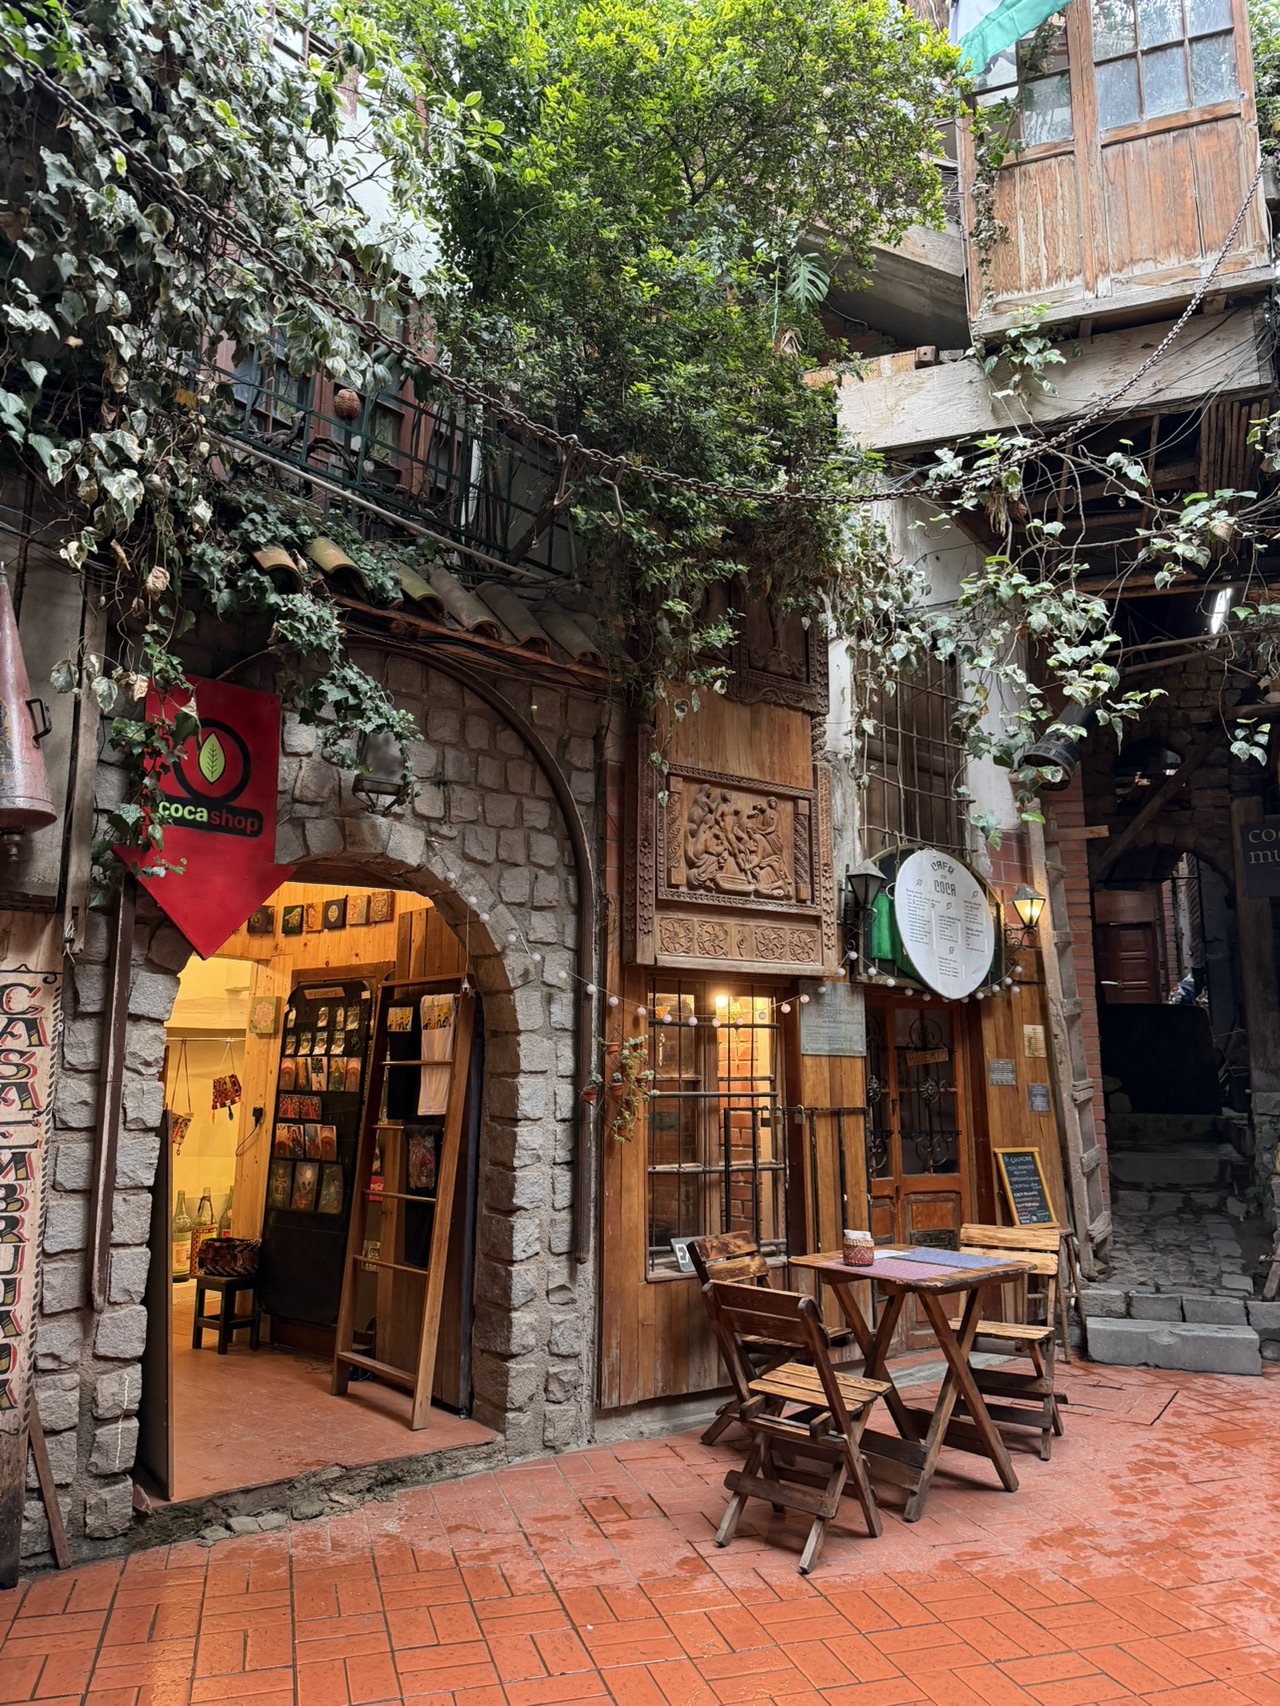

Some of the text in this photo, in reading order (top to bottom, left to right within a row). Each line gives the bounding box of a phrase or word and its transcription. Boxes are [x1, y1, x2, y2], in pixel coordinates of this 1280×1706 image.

[158, 801, 259, 833] coca shop
[1248, 828, 1280, 843] co
[934, 880, 957, 897] COCA
